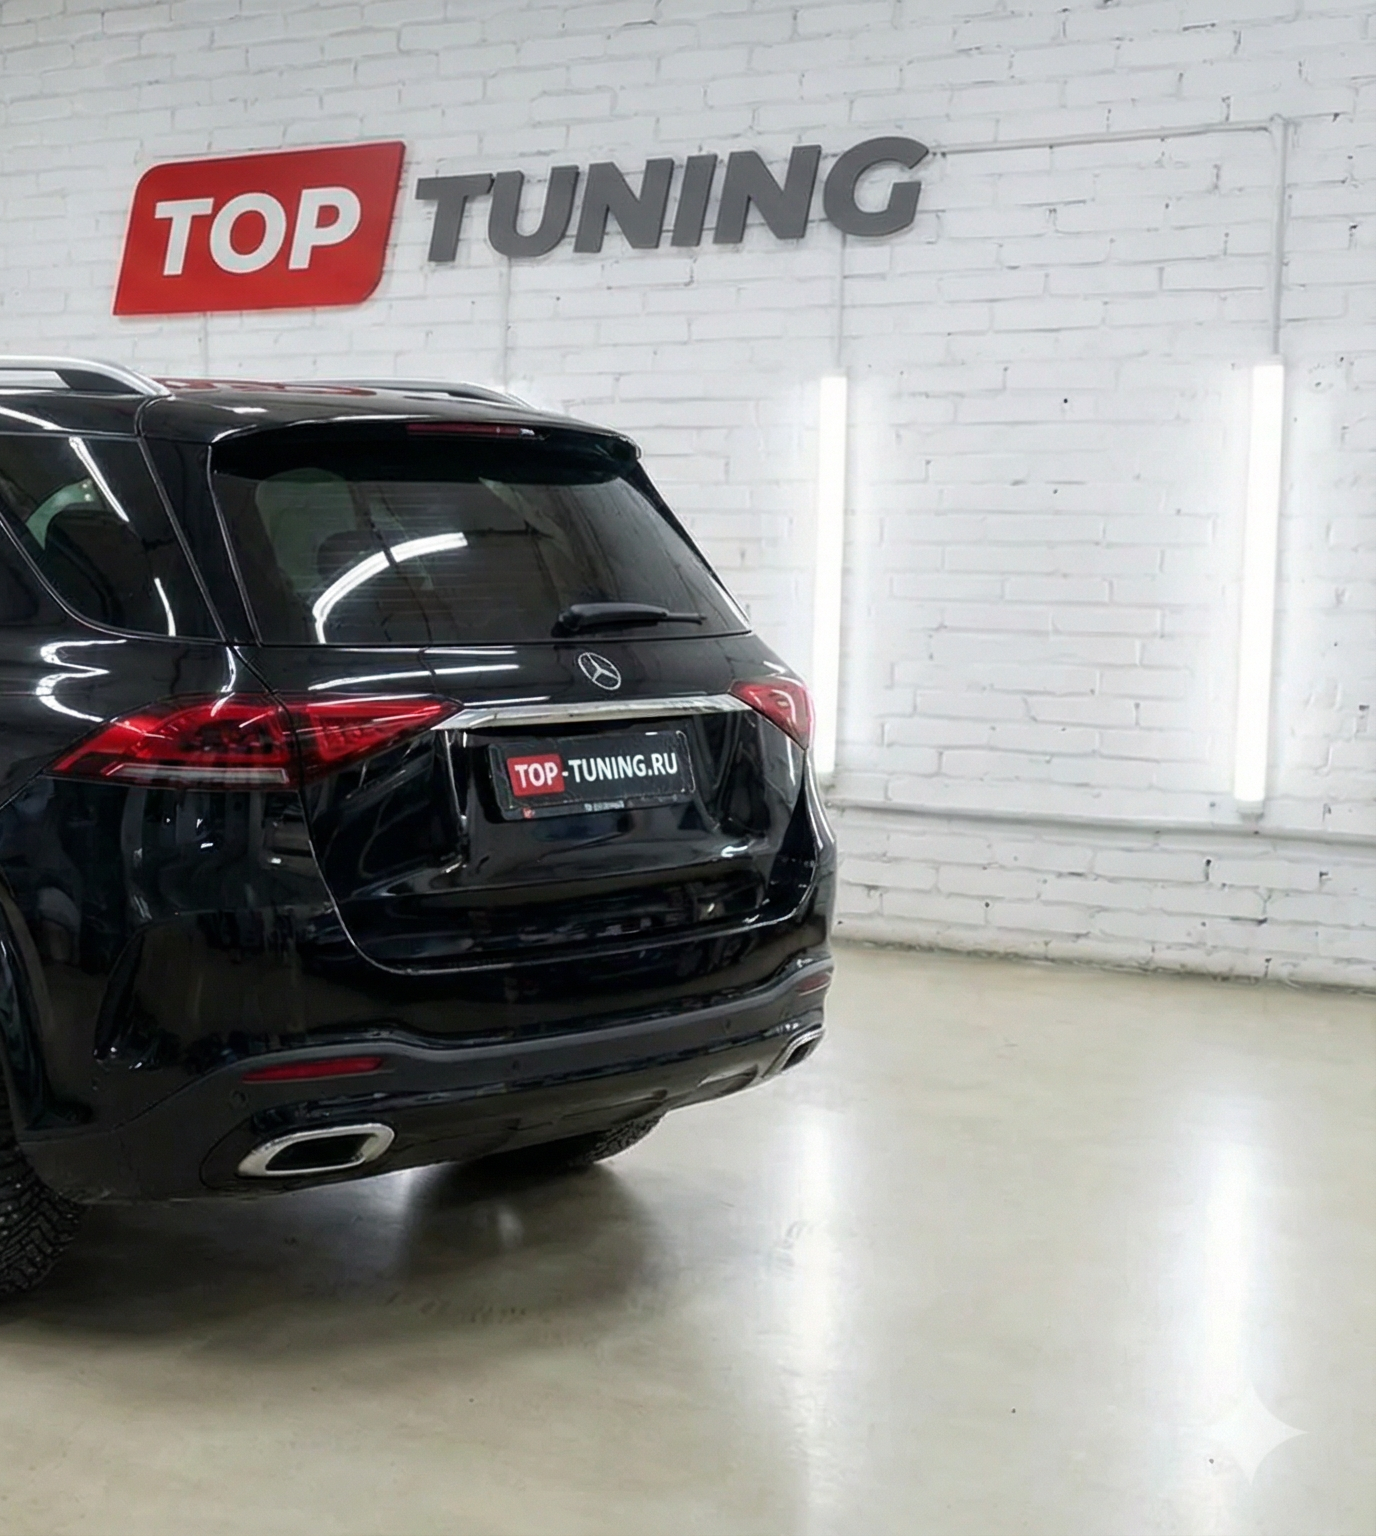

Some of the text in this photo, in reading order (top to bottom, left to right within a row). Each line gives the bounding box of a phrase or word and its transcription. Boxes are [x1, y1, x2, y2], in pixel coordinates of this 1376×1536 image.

[154, 136, 929, 276] TOP TUNING
[514, 752, 678, 789] TOP-TUNING.RU
